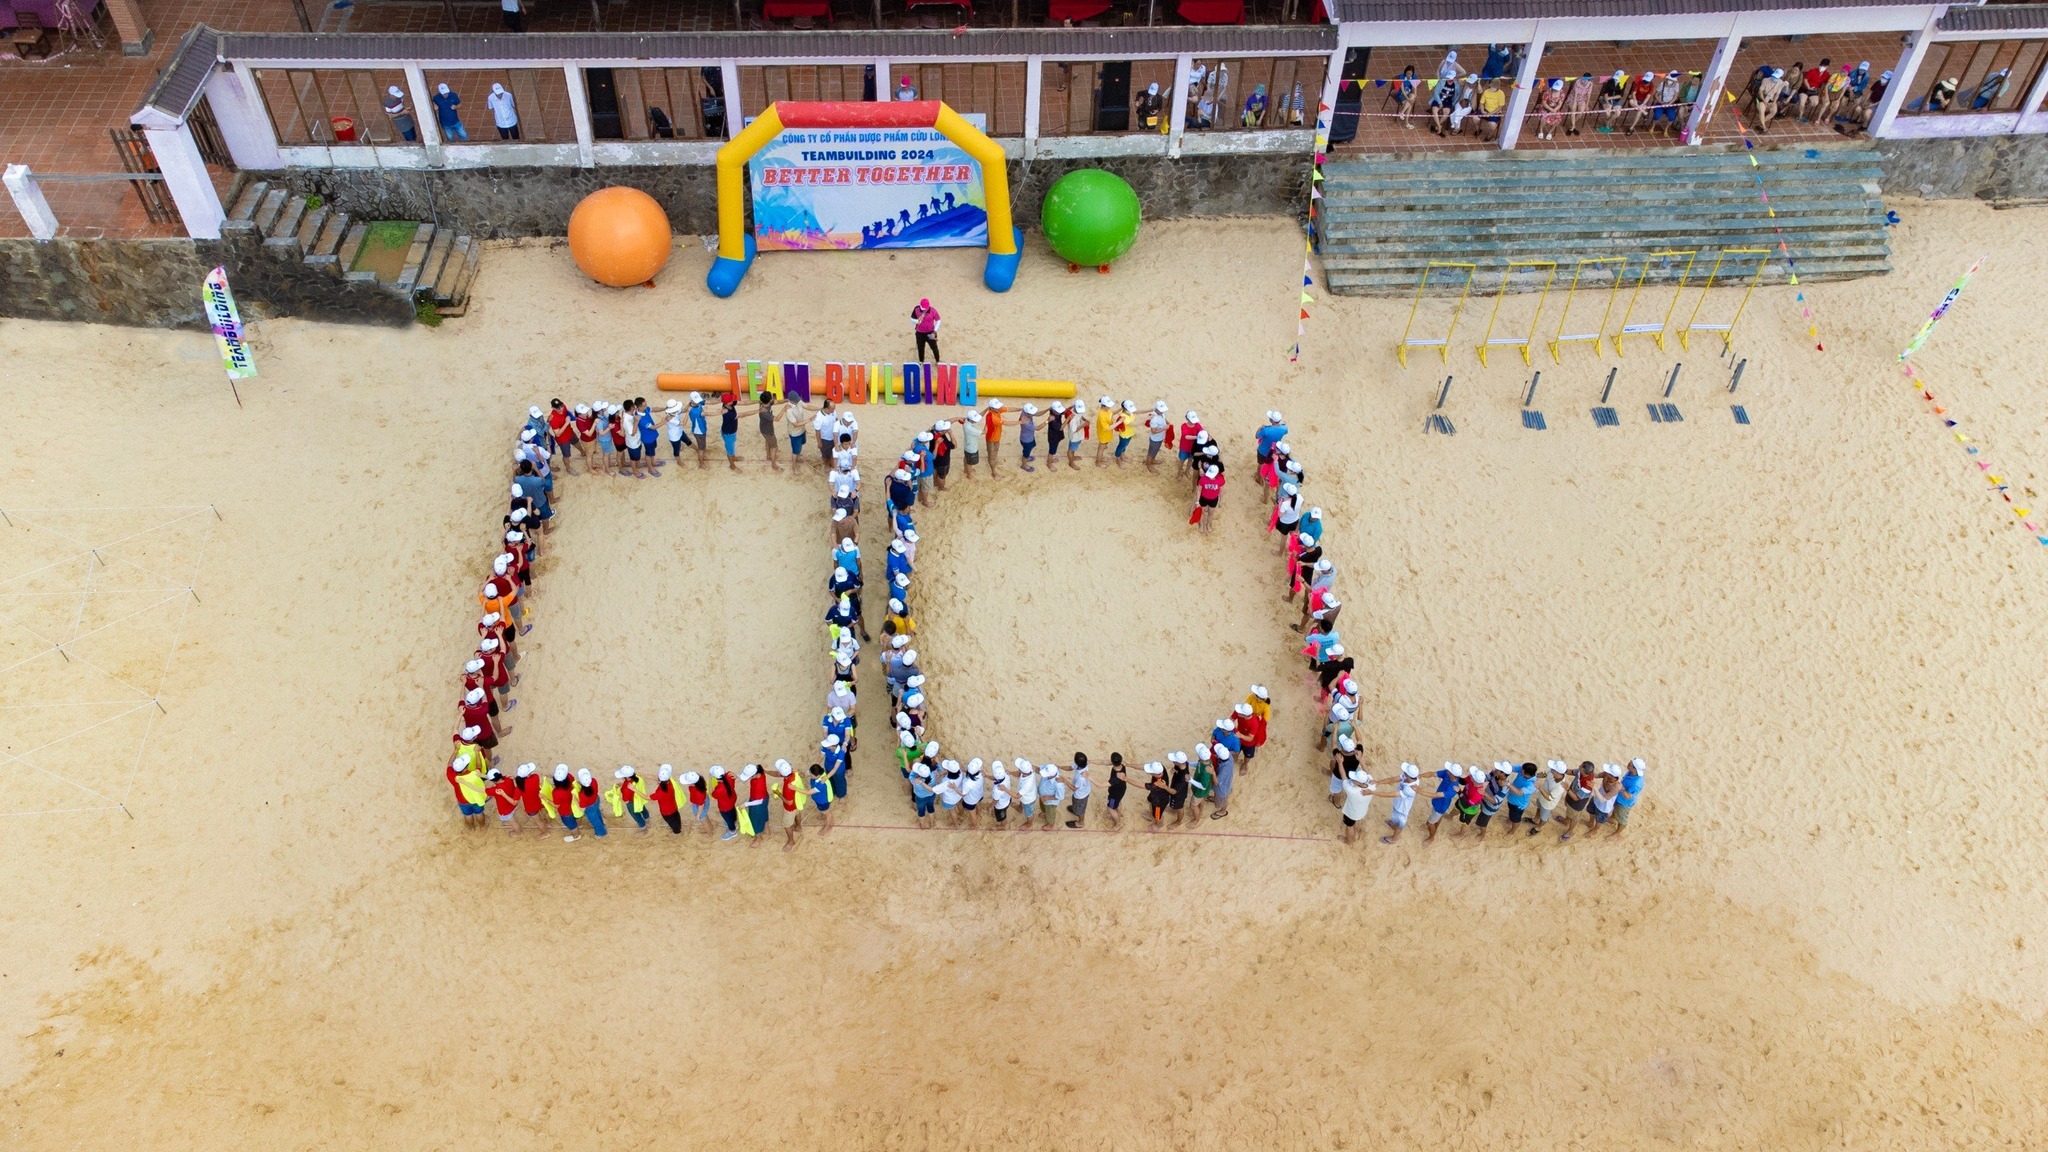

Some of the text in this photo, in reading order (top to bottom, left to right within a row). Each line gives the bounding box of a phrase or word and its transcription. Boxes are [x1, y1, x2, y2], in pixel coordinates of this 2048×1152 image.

[782, 132, 806, 144] CÔNG
[808, 133, 818, 143] TY
[820, 130, 832, 143] CỔ
[859, 132, 881, 144] DƯỢC
[930, 131, 949, 141] LON
[801, 149, 935, 161] TEAMBUILDING 2024
[763, 165, 972, 185] BETTER TOGETHER
[724, 360, 978, 407] TEAM BUILDING
